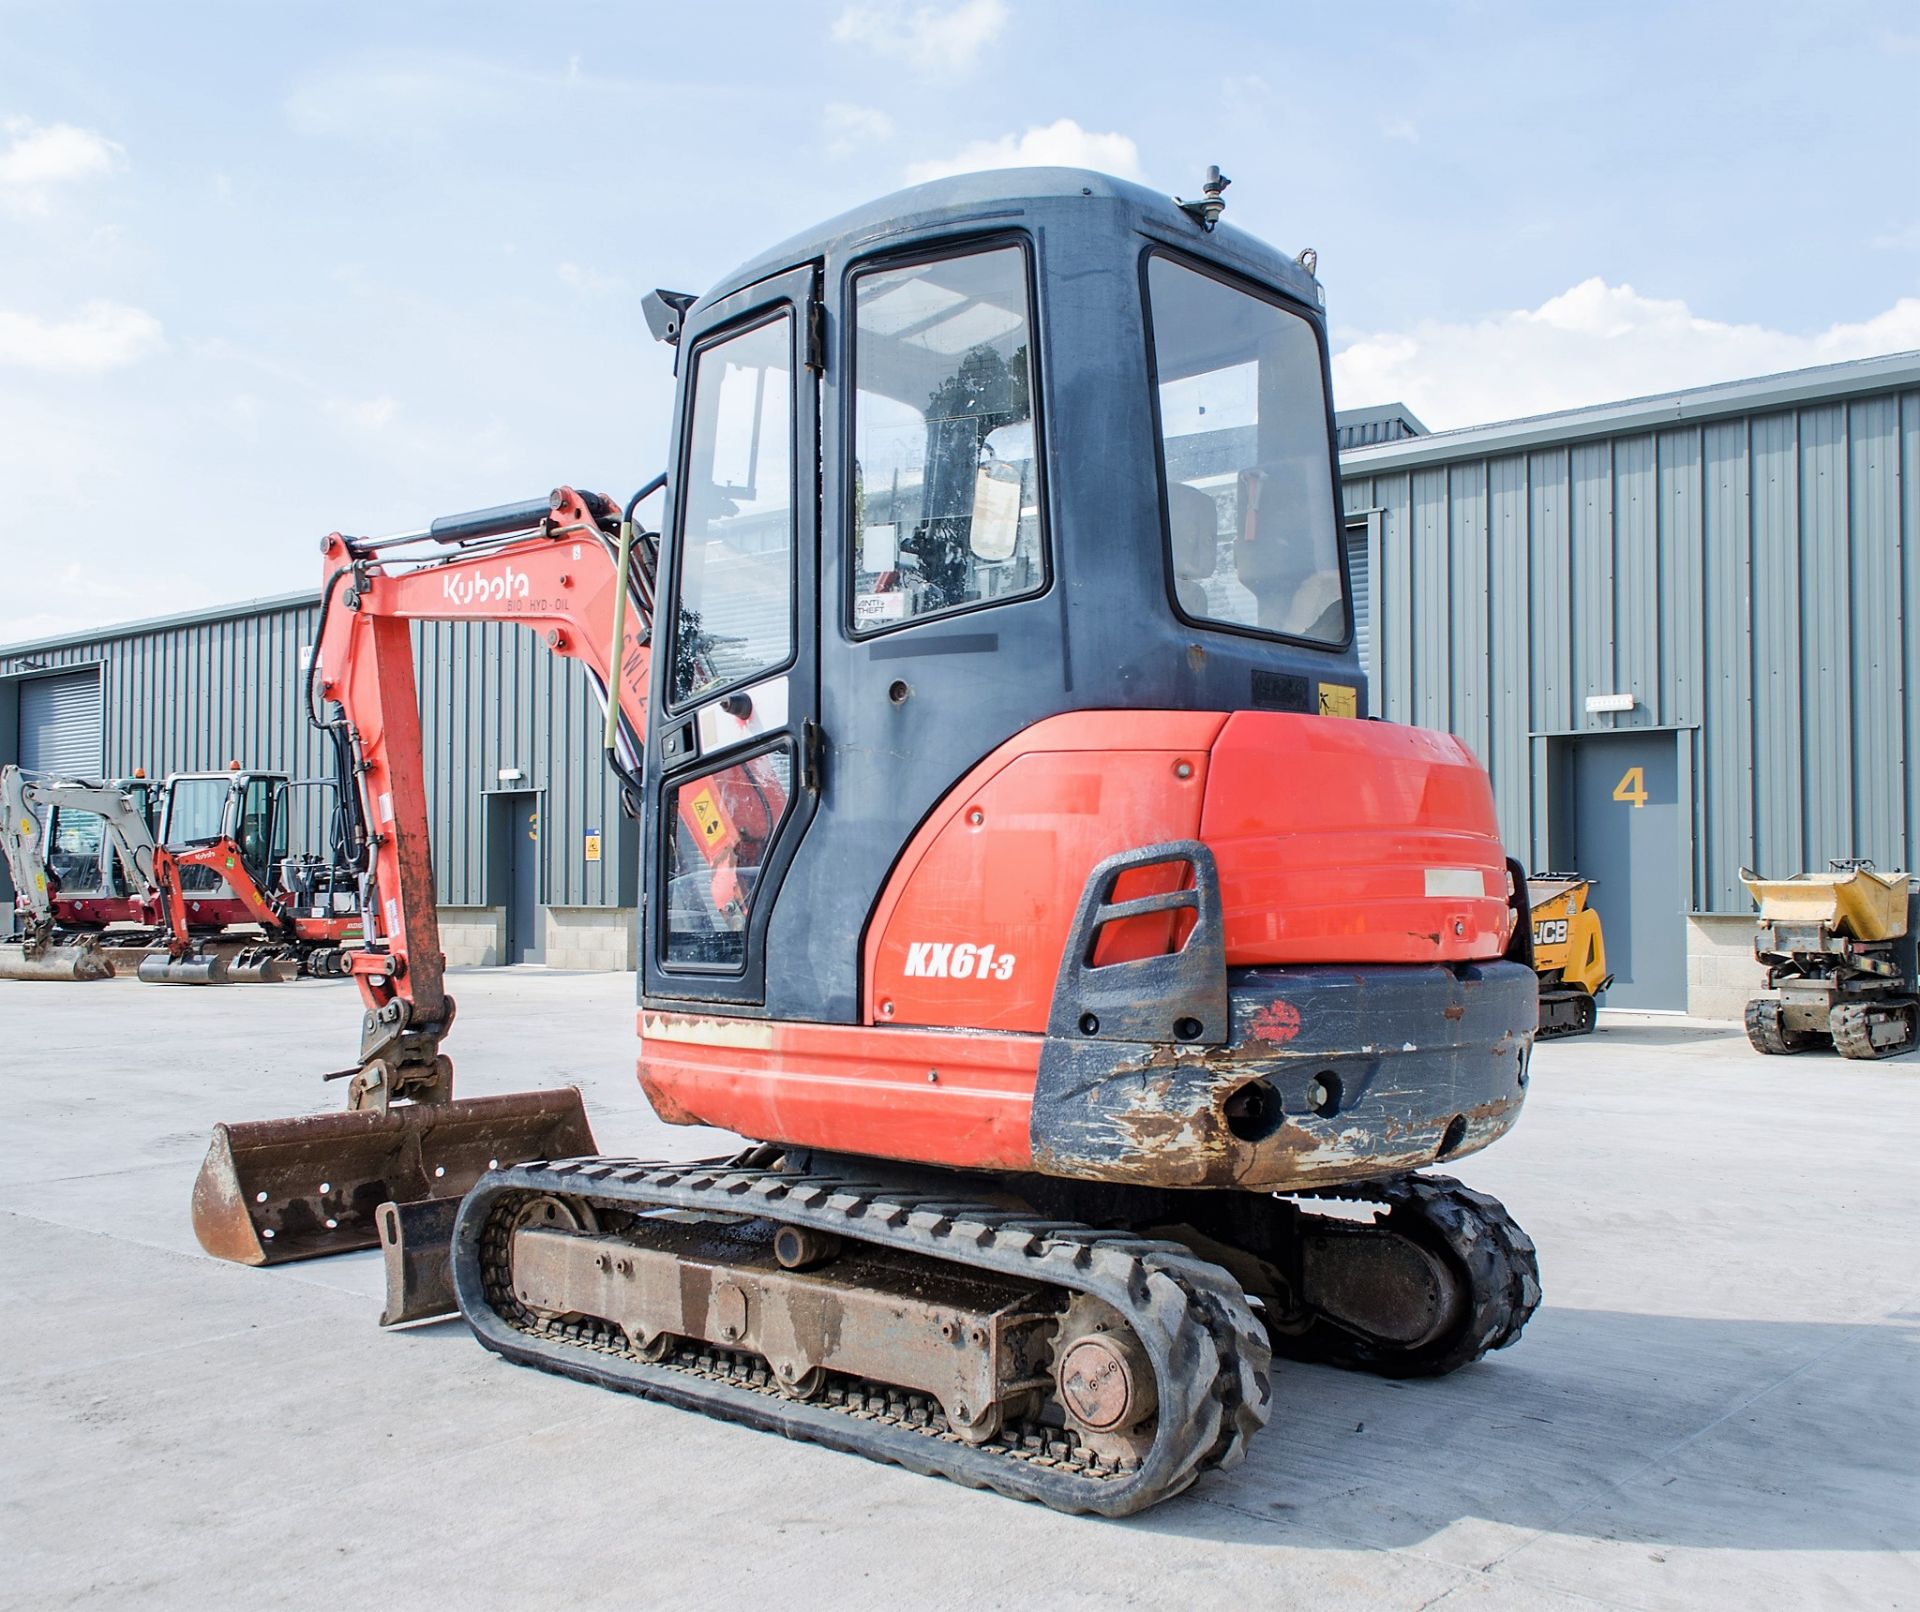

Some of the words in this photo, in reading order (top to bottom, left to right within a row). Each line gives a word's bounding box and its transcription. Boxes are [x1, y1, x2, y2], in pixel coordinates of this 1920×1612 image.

[443, 566, 529, 605] Kubota
[857, 606, 884, 614] THEFT
[1612, 767, 1648, 808] 4
[1533, 920, 1568, 945] JCB
[903, 942, 1016, 980] KX61-3
